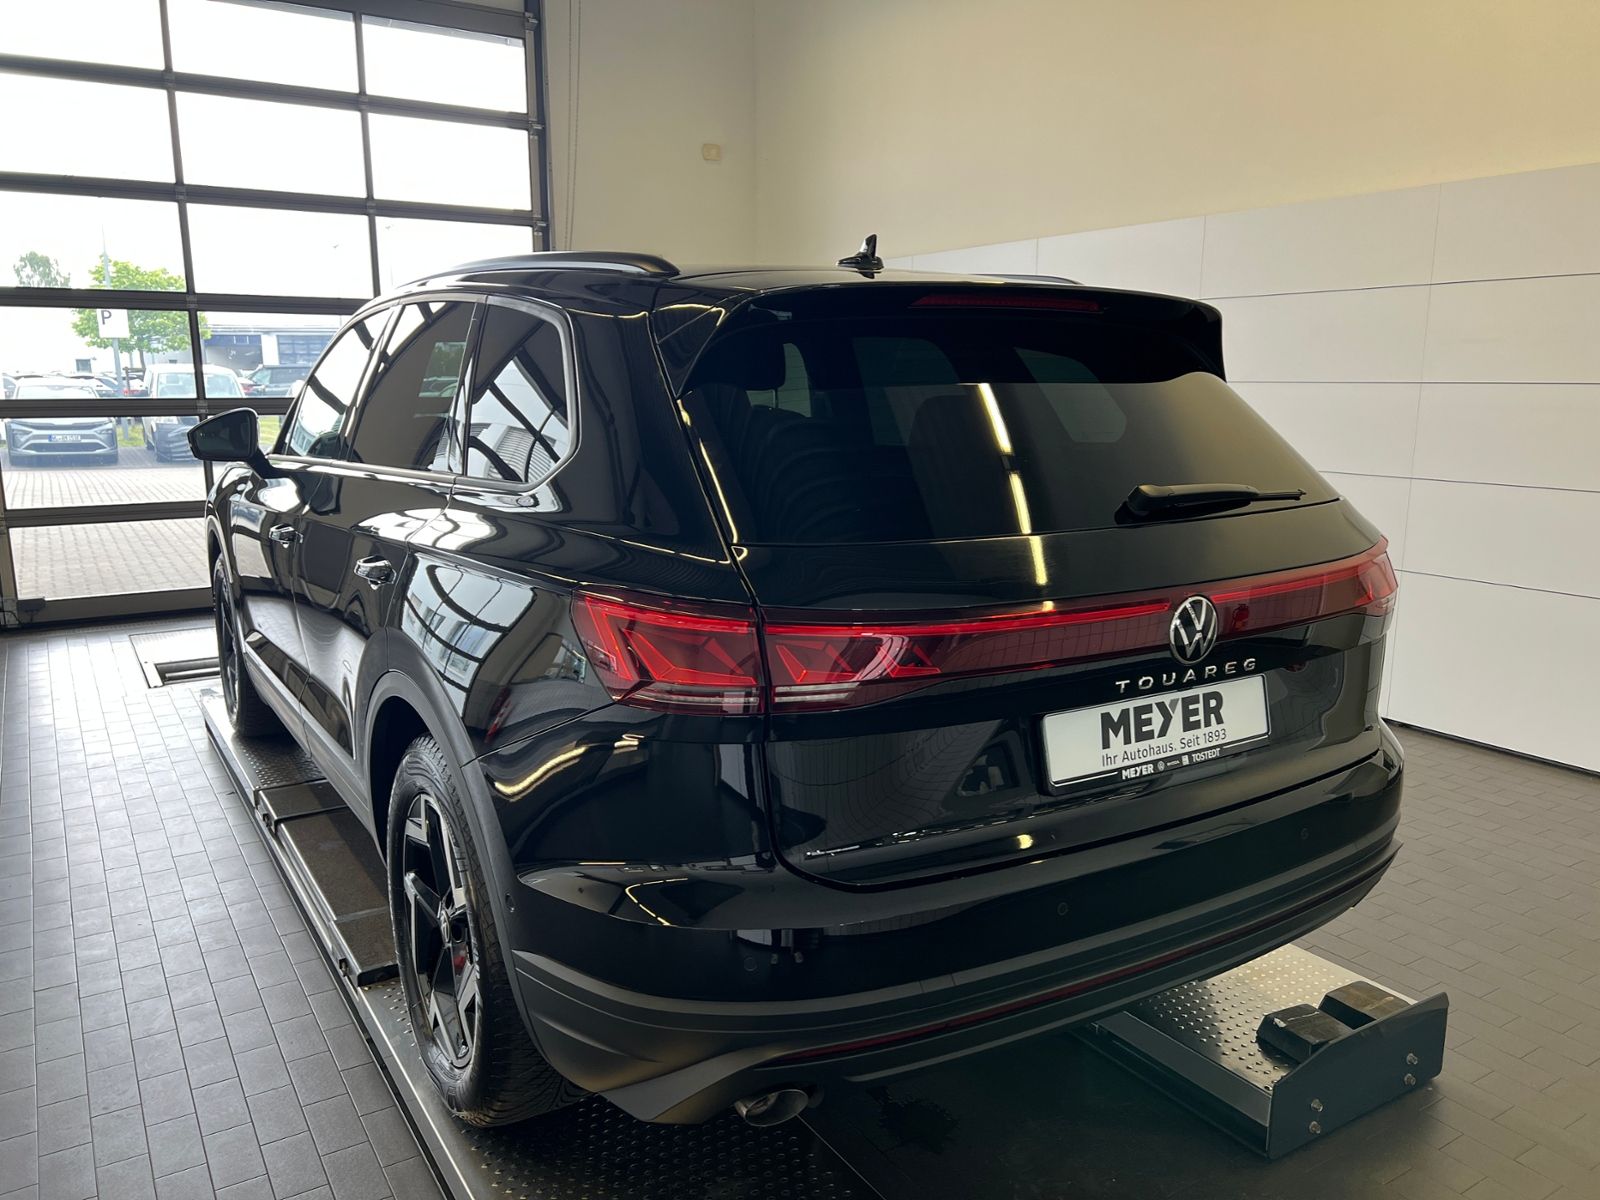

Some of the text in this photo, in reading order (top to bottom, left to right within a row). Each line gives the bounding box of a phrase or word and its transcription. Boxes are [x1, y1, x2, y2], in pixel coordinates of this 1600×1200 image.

[101, 309, 112, 325] P
[1115, 657, 1257, 694] TOUAREG
[1100, 690, 1225, 750] MEYER
[1101, 753, 1118, 767] Ihr
[1121, 742, 1177, 763] Autohaus.
[1179, 734, 1201, 750] Seit
[1203, 728, 1227, 744] 1893
[1121, 763, 1155, 780] MEYER
[1191, 748, 1221, 763] TOSTEDT
